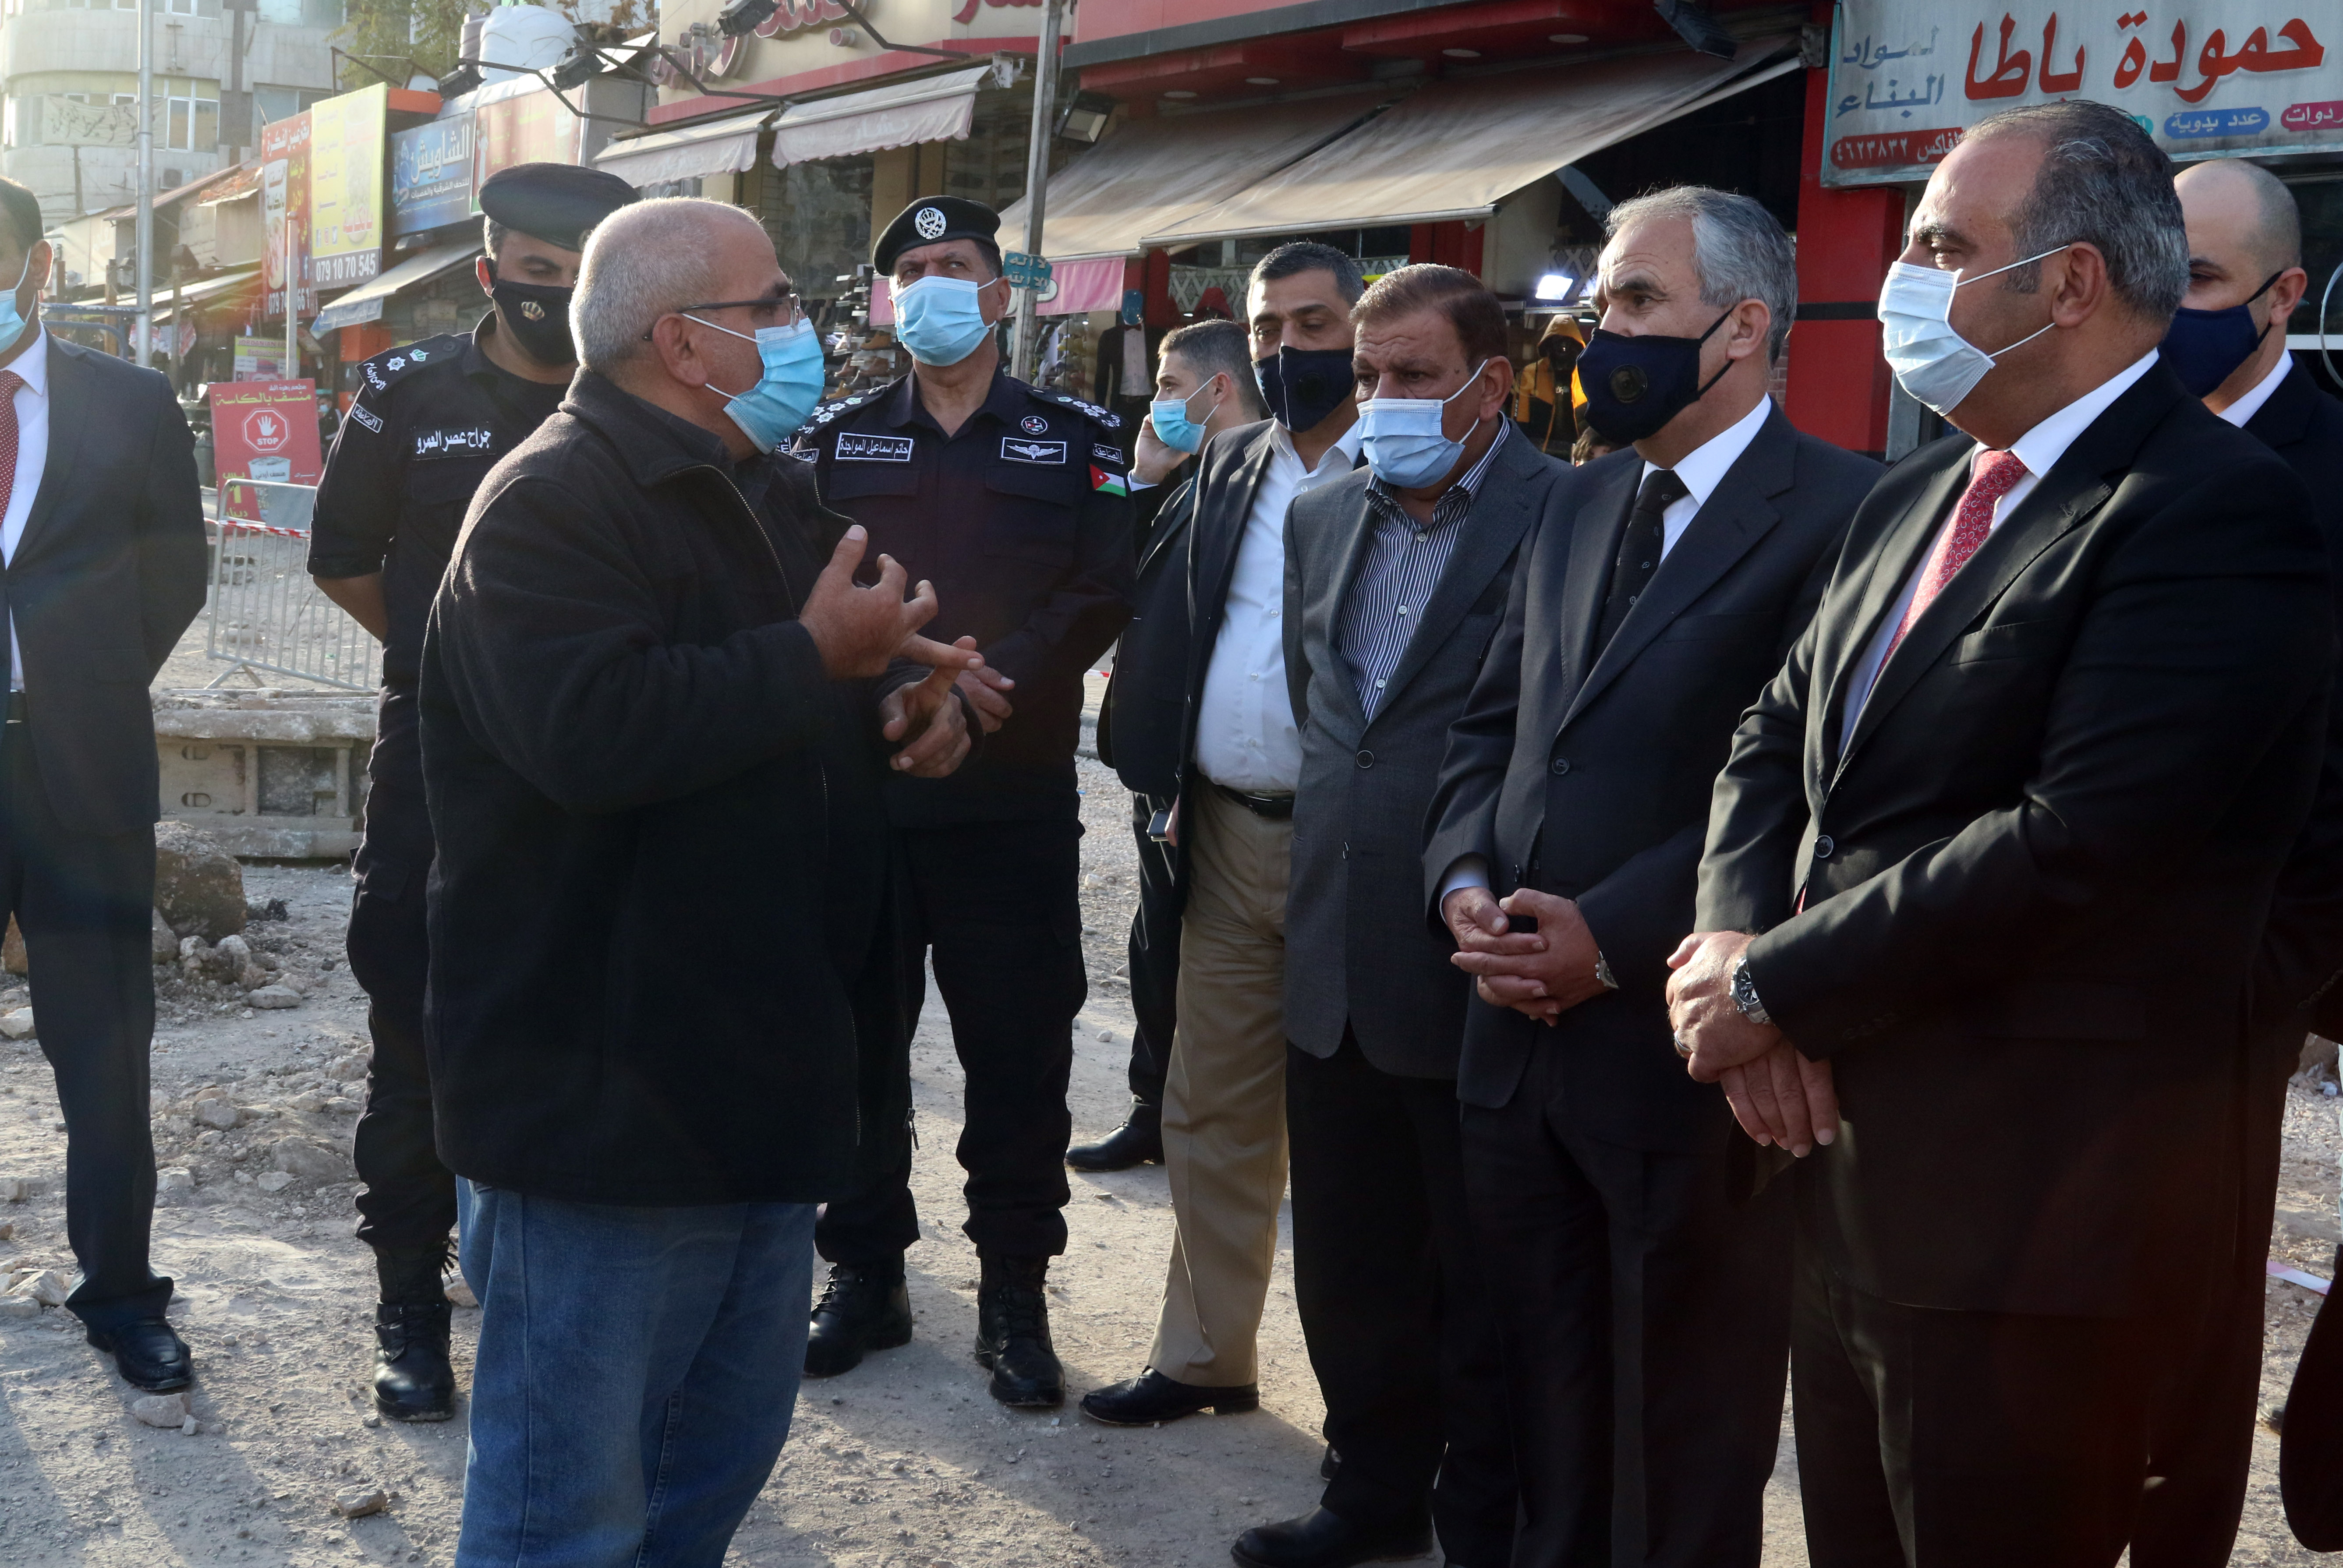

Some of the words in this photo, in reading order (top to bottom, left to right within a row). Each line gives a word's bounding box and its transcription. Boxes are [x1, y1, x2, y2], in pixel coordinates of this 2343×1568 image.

[1965, 11, 2085, 102] باطا
[2113, 10, 2325, 103] حمودة
[1836, 73, 1944, 118] البناء
[2171, 113, 2219, 133] يدوية
[2228, 113, 2262, 127] عدد
[411, 123, 470, 184] الشاويش
[1837, 139, 1908, 161] ٤٦٢٣٨٣٢
[434, 181, 453, 194] الشرقية
[316, 261, 330, 282] 079
[333, 257, 343, 279] 10
[345, 256, 356, 278] 70
[358, 253, 375, 276] 545
[215, 392, 272, 406] بالكاسة
[274, 392, 311, 402] منسف
[416, 431, 441, 454] العمرو
[467, 427, 491, 449] جراح
[867, 440, 893, 456] اسماعيل
[1094, 445, 1120, 460] الصاعقة
